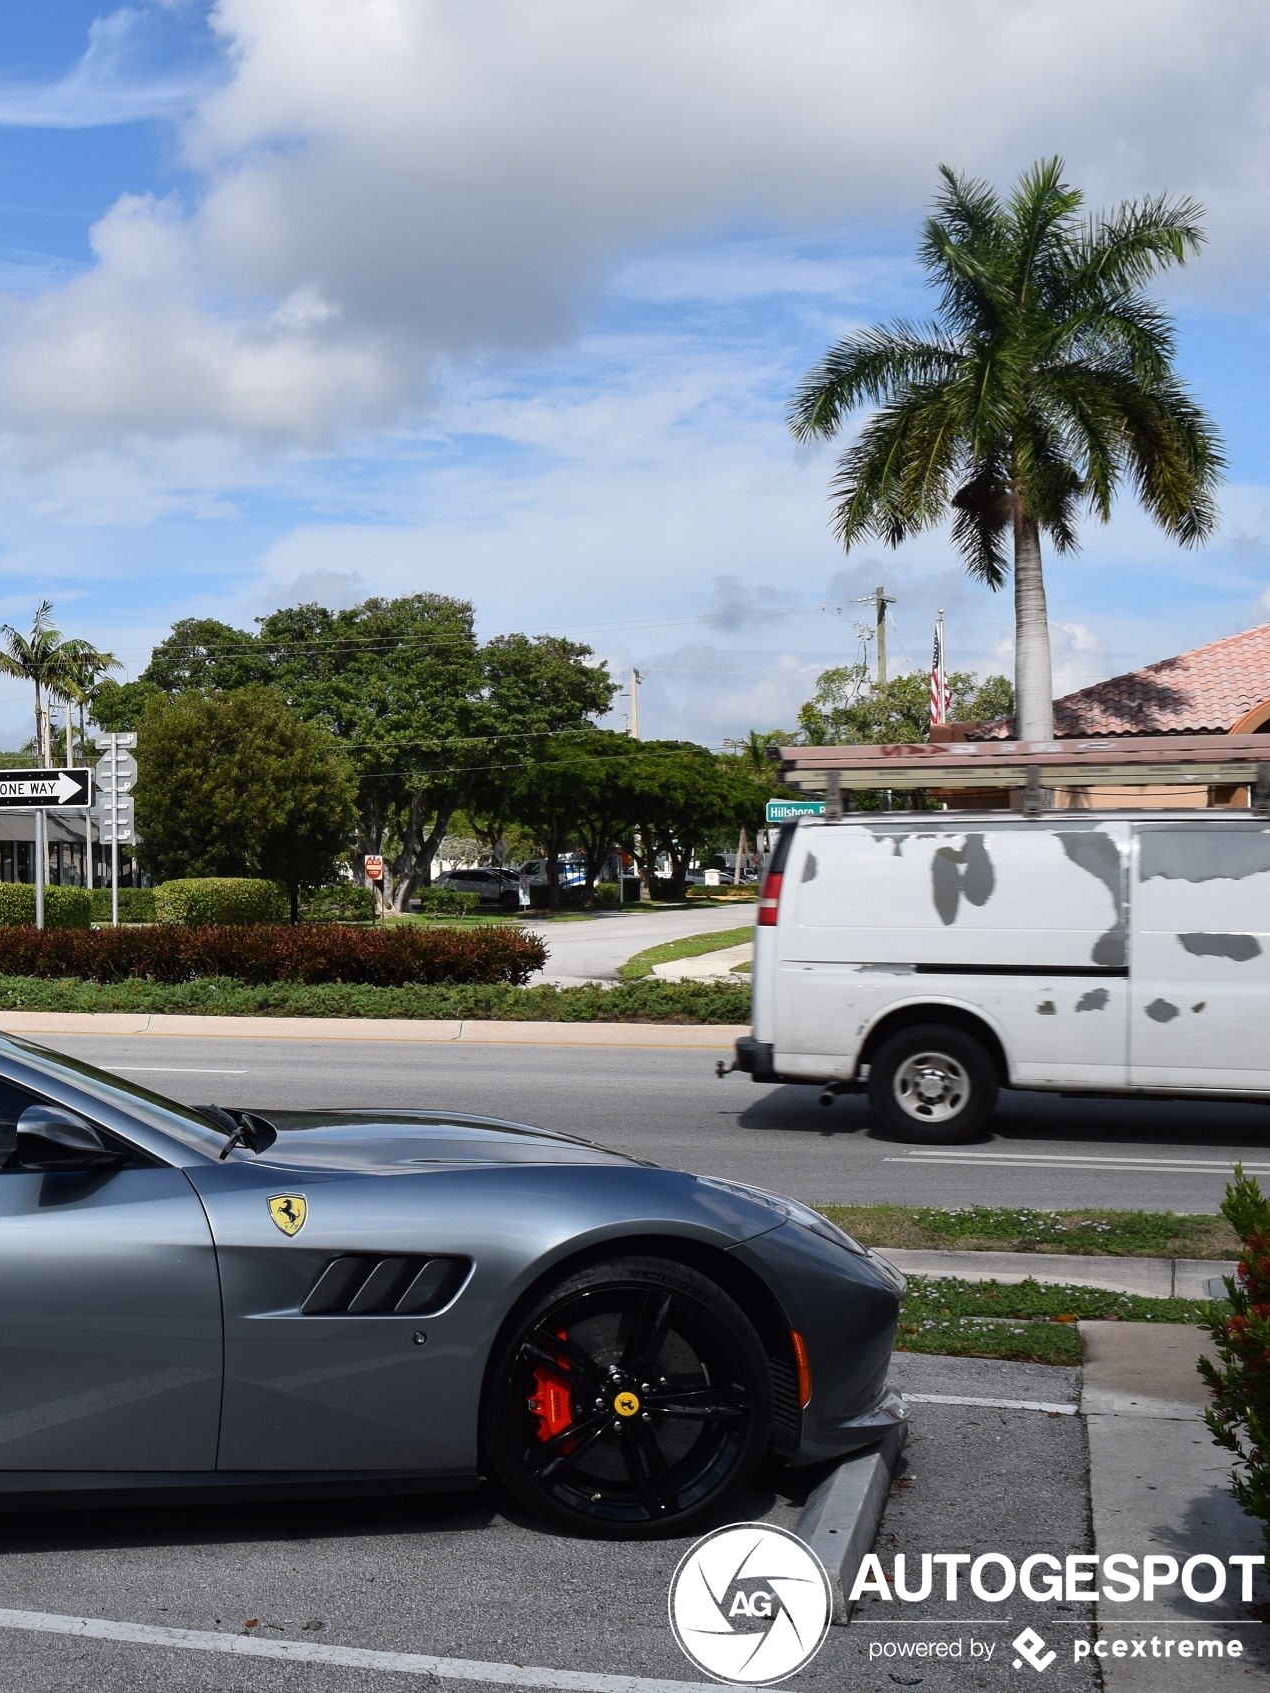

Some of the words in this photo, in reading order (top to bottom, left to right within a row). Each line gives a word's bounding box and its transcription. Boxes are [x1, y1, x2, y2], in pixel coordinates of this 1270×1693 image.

[0, 783, 25, 795] ONE
[30, 782, 56, 795] WAY
[770, 806, 814, 818] Hillsboro
